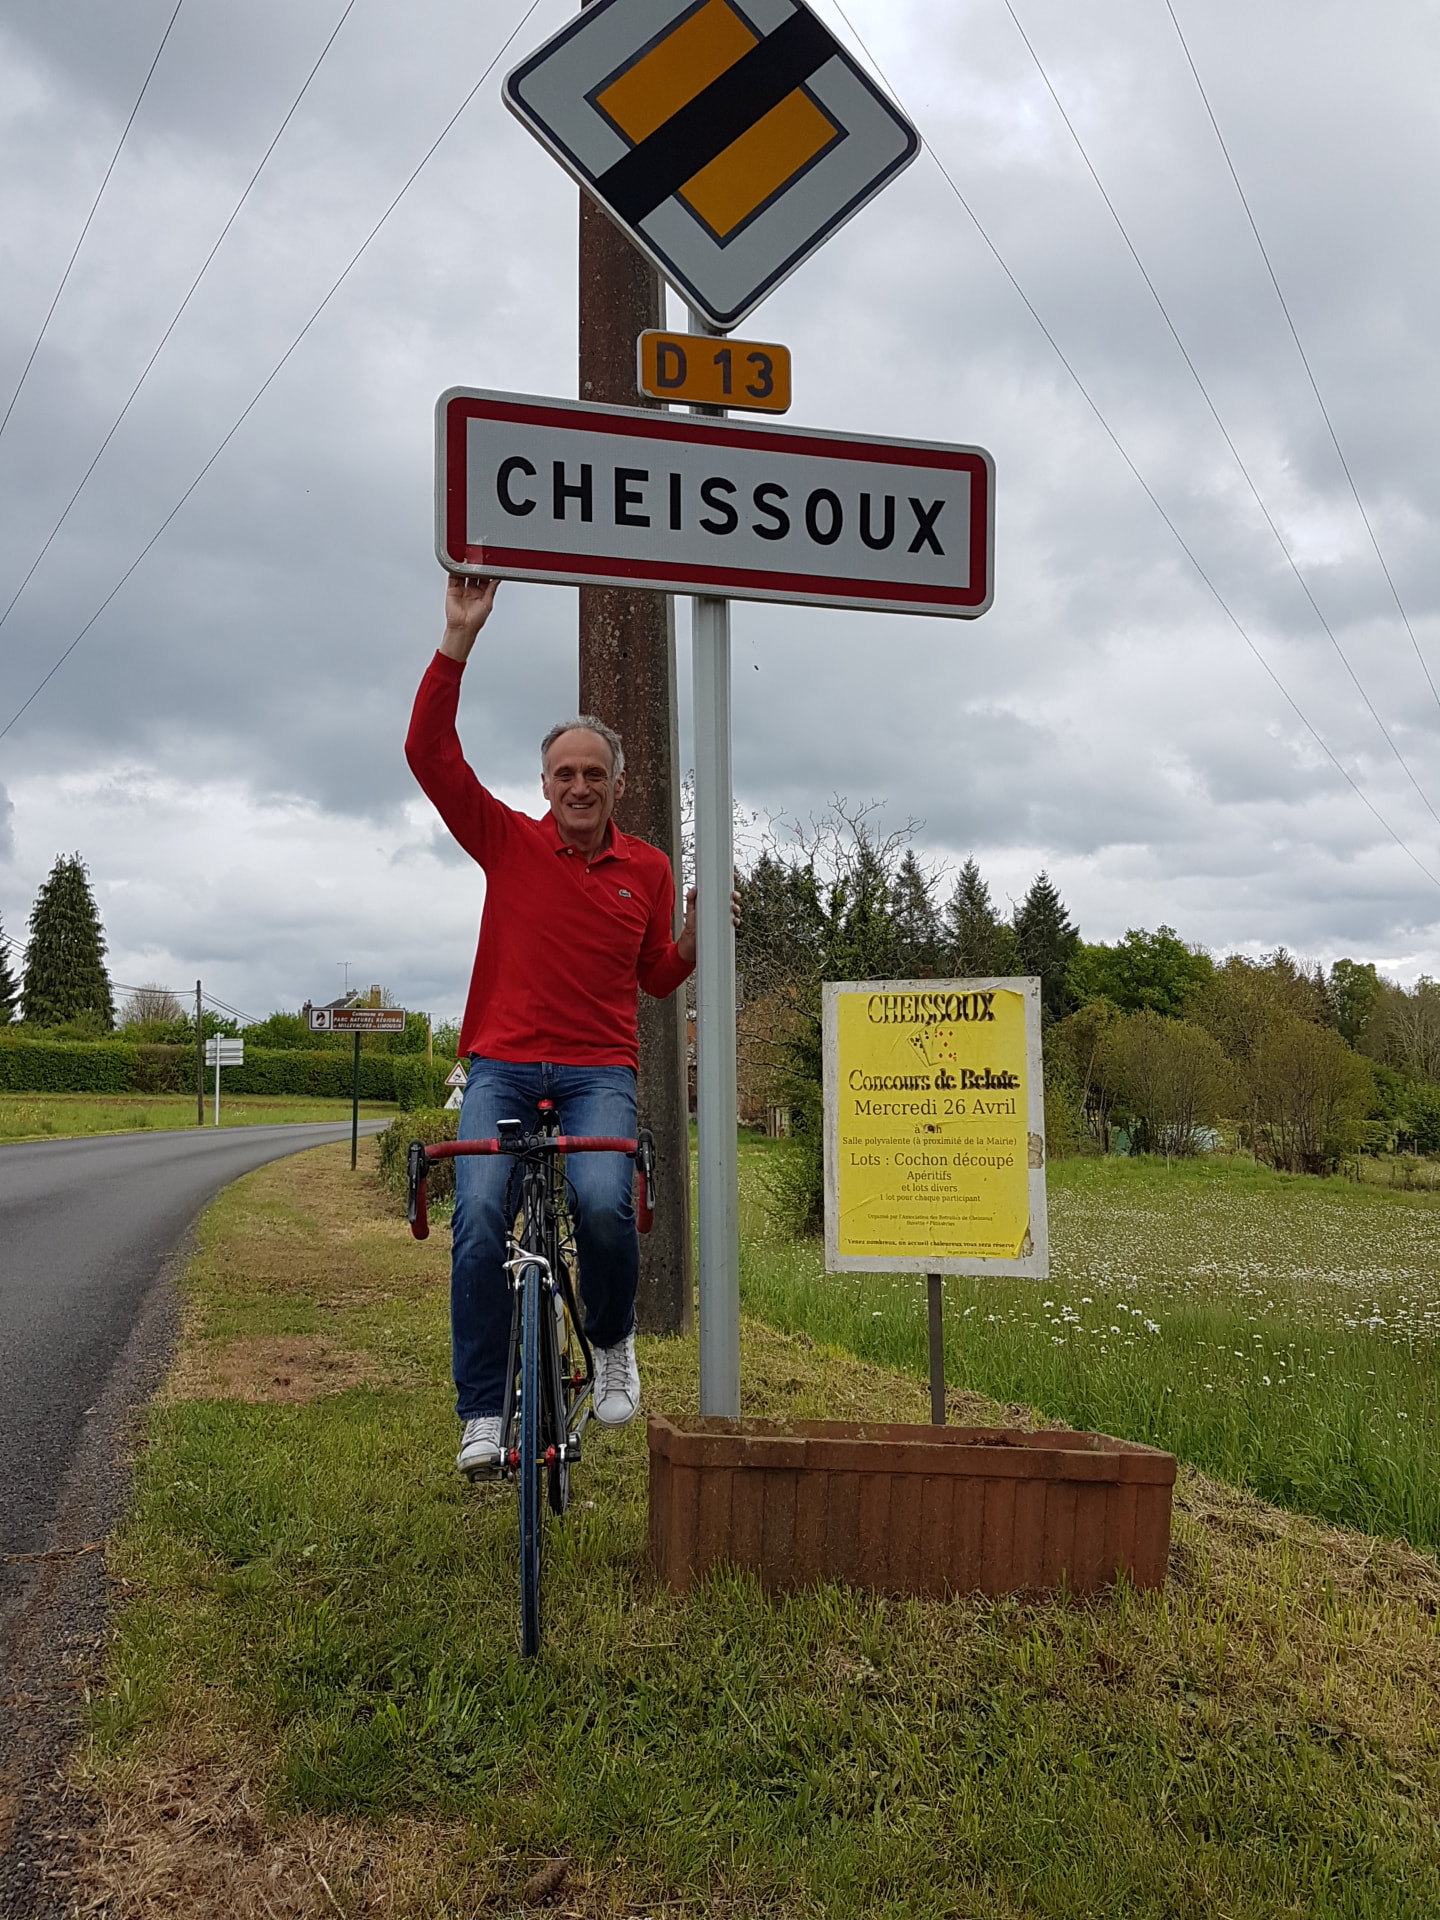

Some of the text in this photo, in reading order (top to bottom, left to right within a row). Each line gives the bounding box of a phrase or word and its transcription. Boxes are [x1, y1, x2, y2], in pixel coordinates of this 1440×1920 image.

[655, 340, 774, 398] D 13
[495, 455, 946, 556] CHEISSOUX
[867, 993, 997, 1023] CHEISSOUX
[849, 1069, 931, 1092] Concours
[934, 1068, 957, 1090] de
[854, 1098, 1017, 1116] Mercredi 26 Avril
[914, 1123, 921, 1134] à
[842, 1136, 1017, 1147] Salle polyvalente (à proximité de la Mairie)
[850, 1152, 881, 1166] Lots
[894, 1152, 948, 1166] Cochon
[952, 1152, 1014, 1169] découpé
[906, 1170, 952, 1182] Apéritifs
[901, 1183, 958, 1192] et lots divers
[885, 1193, 895, 1201] lot
[896, 1195, 913, 1203] pour
[914, 1194, 940, 1203] chaque
[941, 1194, 981, 1203] participant
